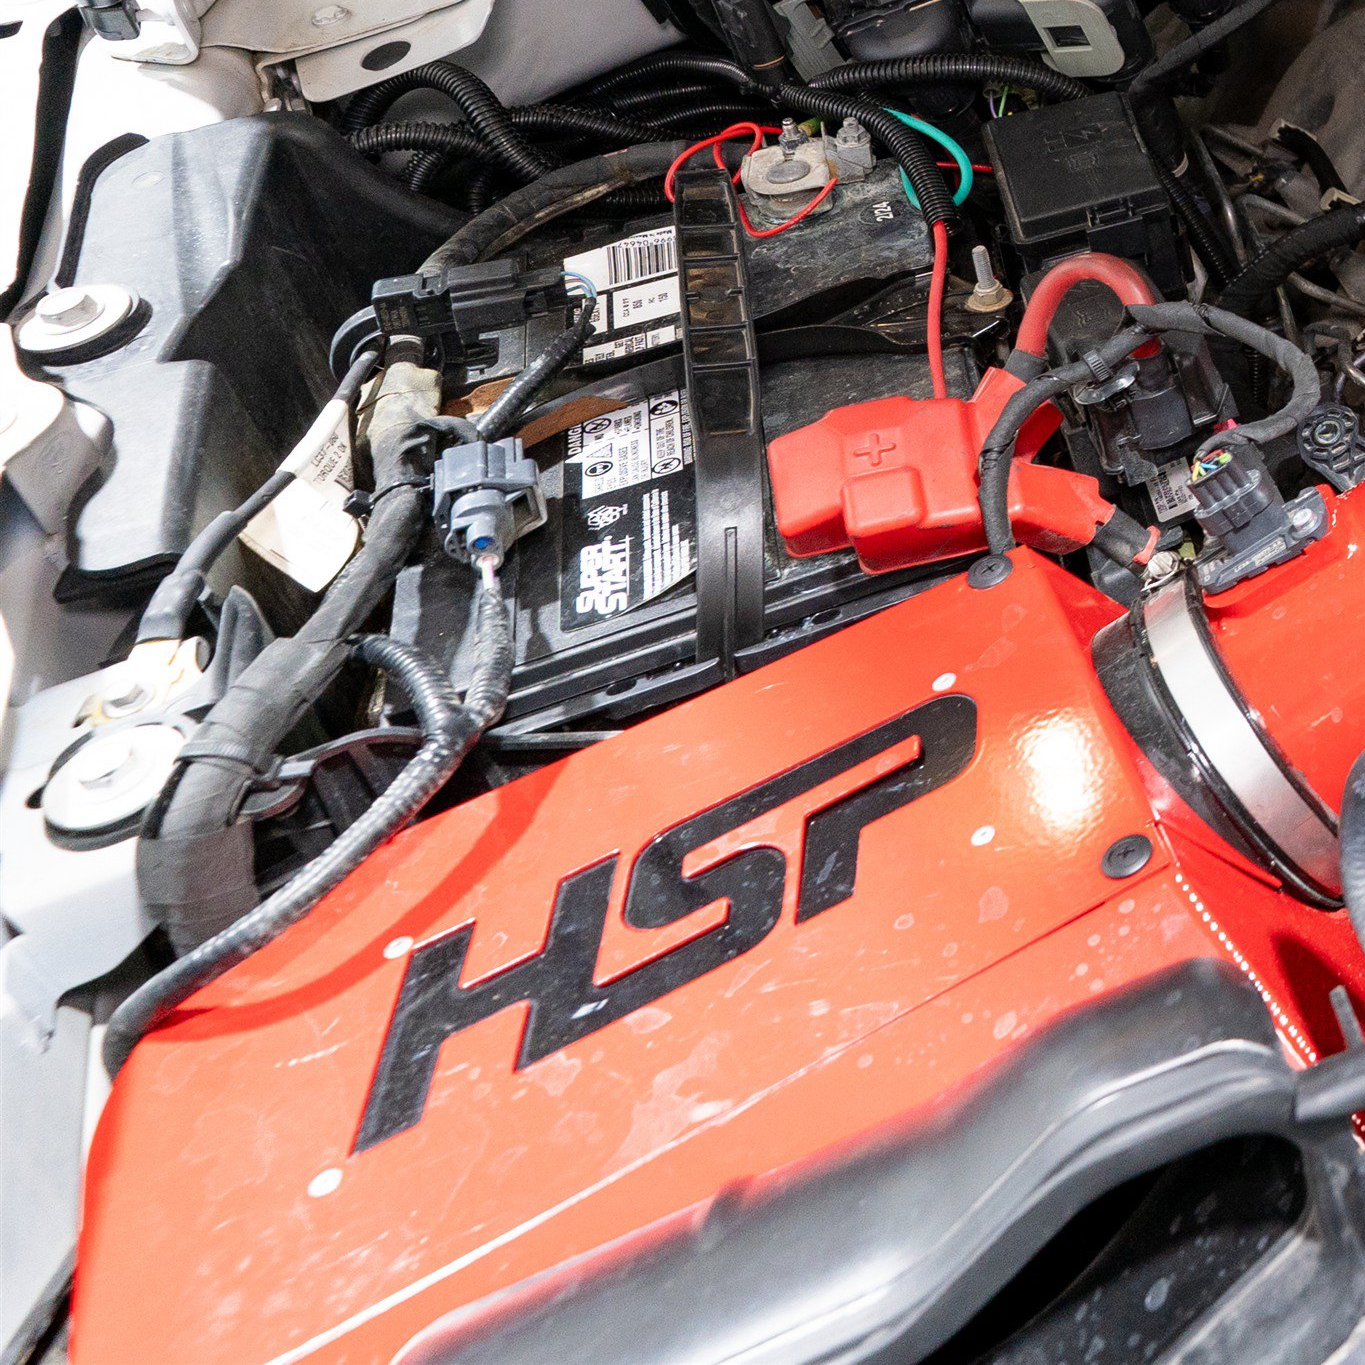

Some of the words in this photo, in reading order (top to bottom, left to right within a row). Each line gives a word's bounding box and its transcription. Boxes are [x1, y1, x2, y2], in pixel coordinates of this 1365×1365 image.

[567, 424, 582, 455] DANG
[576, 543, 601, 614] SUPER
[595, 536, 629, 615] START
[350, 693, 978, 1158] HSP
